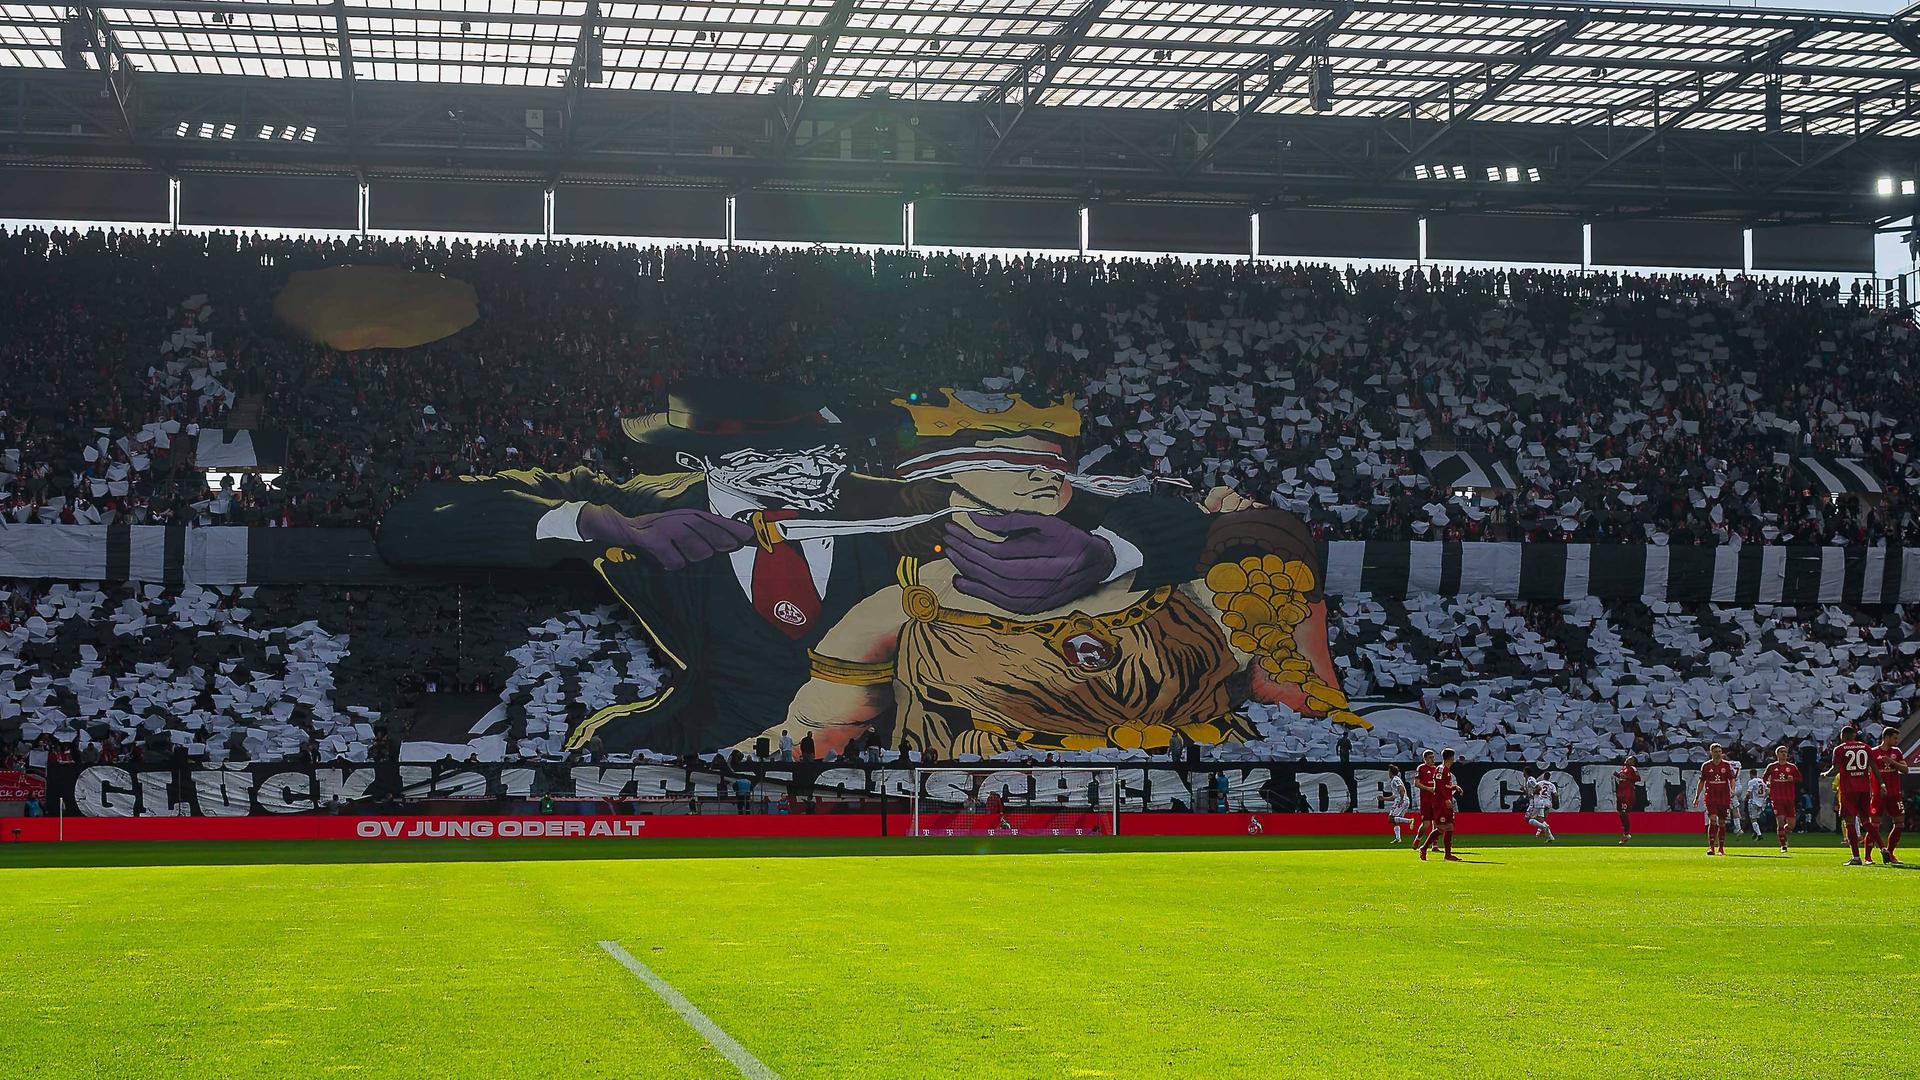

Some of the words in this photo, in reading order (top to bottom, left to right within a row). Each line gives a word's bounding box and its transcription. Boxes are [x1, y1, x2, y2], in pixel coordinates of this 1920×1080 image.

[1845, 749, 1868, 771] 20
[74, 762, 376, 817] GLÜCK
[814, 766, 1272, 813] GESCHENK
[356, 821, 405, 837] OV
[407, 820, 494, 837] JUNG
[498, 820, 586, 837] ODER
[589, 820, 646, 837] ALT
